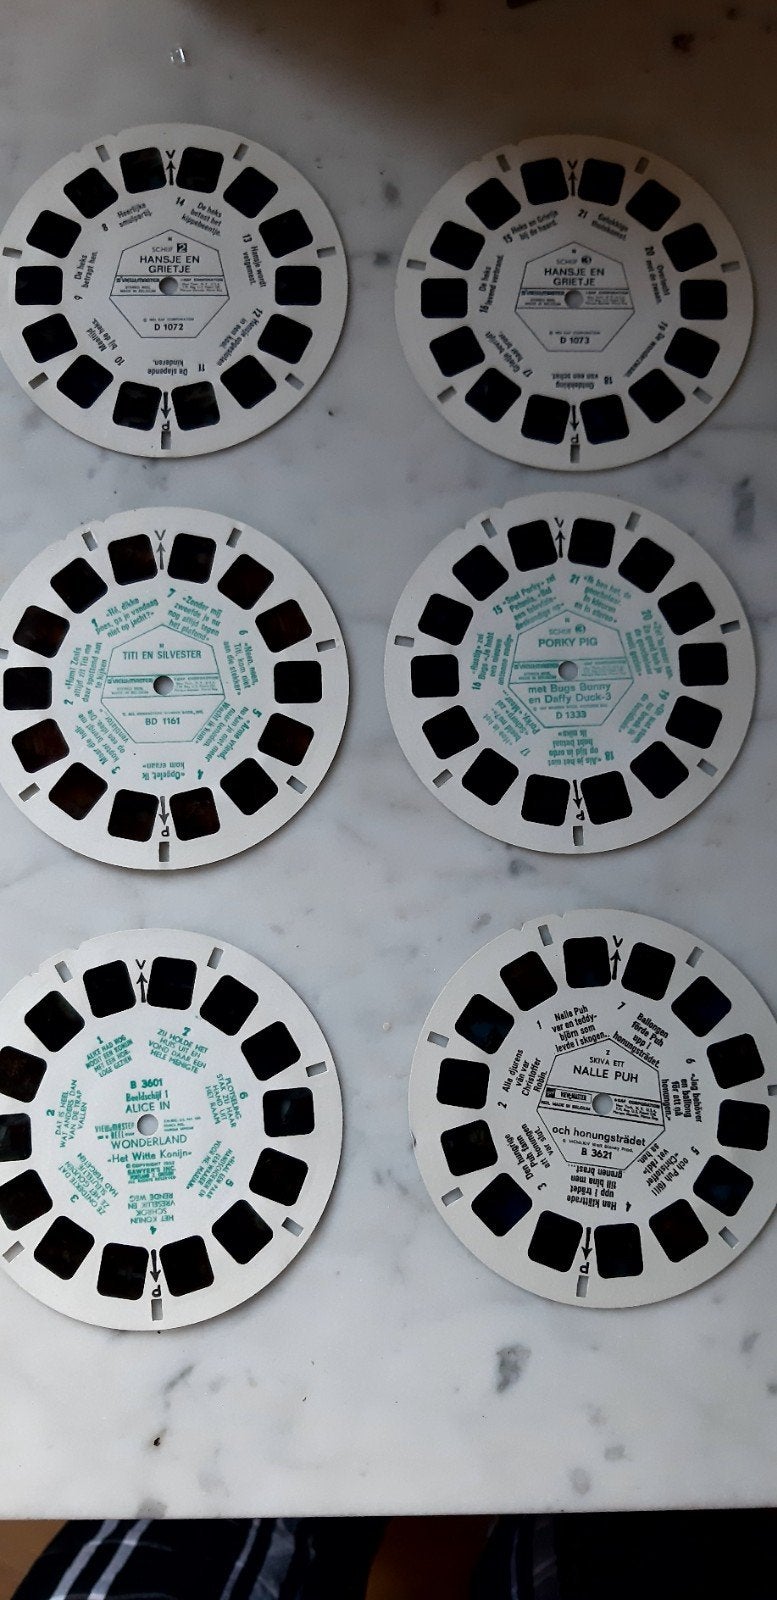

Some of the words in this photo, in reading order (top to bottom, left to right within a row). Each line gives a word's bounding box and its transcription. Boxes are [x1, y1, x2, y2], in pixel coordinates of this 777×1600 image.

[166, 150, 175, 159] V
[177, 243, 187, 253] 2
[148, 265, 190, 273] GRIETJE
[544, 268, 585, 276] HANSJE
[553, 278, 595, 286] GRIETJE
[148, 366, 177, 376] slapende
[556, 380, 594, 389] Ontdekking
[604, 376, 612, 384] 18
[554, 518, 564, 528] V
[155, 530, 166, 540] V
[168, 610, 180, 620] nog
[182, 617, 199, 627] altijd
[201, 624, 219, 636] tegen
[538, 638, 576, 647] PORKY
[579, 637, 598, 646] PIG
[123, 651, 138, 660] TITI
[158, 650, 201, 659] SILVESTER
[550, 684, 575, 693] Bugs
[579, 683, 611, 691] Bunny
[545, 694, 571, 703] Daffy
[576, 692, 611, 701] Duck-3
[78, 714, 87, 723] me
[556, 711, 562, 719] D
[86, 724, 103, 743] brengt
[102, 744, 119, 762] kopter
[198, 769, 203, 780] 4
[613, 935, 623, 948] V
[136, 959, 146, 970] V
[554, 1010, 573, 1021] Nalle
[574, 1005, 588, 1015] Puh
[552, 1024, 563, 1032] var
[574, 1014, 597, 1026] teddy-
[637, 1013, 668, 1038] Ballongen
[559, 1030, 578, 1041] björn
[580, 1025, 596, 1034] som
[632, 1021, 649, 1036] förde
[649, 1033, 663, 1047] Puh
[633, 1035, 646, 1046] upp
[149, 1040, 169, 1053] VOND
[172, 1050, 191, 1062] DAAR
[193, 1059, 206, 1068] EEN
[613, 1031, 660, 1068] honungsträdet.
[150, 1048, 167, 1060] HELE
[169, 1057, 199, 1073] MENIGTE
[590, 1057, 609, 1065] SKIVA
[502, 1078, 513, 1092] Alla
[509, 1050, 523, 1075] djurens
[516, 1072, 525, 1086] vän
[521, 1060, 529, 1071] var
[522, 1058, 541, 1096] Christoffer
[574, 1065, 609, 1078] NALLE
[615, 1071, 638, 1083] PUH
[130, 1080, 137, 1089] B
[142, 1078, 162, 1088] 3601
[533, 1071, 547, 1092] Robin.
[672, 1081, 680, 1092] för
[681, 1079, 688, 1088] en
[126, 1090, 161, 1102] Beeldschijf
[165, 1090, 168, 1098] 1
[225, 1078, 241, 1119] PLOTSELING
[126, 1102, 154, 1113] ALICE
[160, 1101, 170, 1110] IN
[205, 1086, 214, 1098] HET
[210, 1102, 221, 1124] RAAM
[682, 1090, 692, 1117] ballong
[78, 1102, 87, 1129] VALLEN
[673, 1107, 683, 1116] nå
[532, 1126, 546, 1142] slut.
[552, 1127, 570, 1135] och
[574, 1128, 645, 1146] honungsträdet
[111, 1134, 187, 1149] WONDERLAND
[513, 1135, 529, 1152] fann
[522, 1124, 543, 1157] honungen
[505, 1134, 527, 1165] hungrige
[544, 1144, 553, 1156] var
[650, 1143, 659, 1152] sa
[691, 1146, 700, 1155] 5
[108, 1154, 128, 1162] «Het
[132, 1152, 156, 1160] Witte
[160, 1149, 192, 1158] Konijn»
[526, 1152, 538, 1168] Puh
[591, 1149, 612, 1159] 3621
[638, 1151, 653, 1163] han.
[77, 1153, 104, 1182] VERGETEN
[540, 1158, 550, 1168] att
[522, 1164, 534, 1180] Den
[646, 1153, 678, 1186] «Christoffer
[78, 1164, 107, 1196] SLEUTELTJE
[589, 1177, 604, 1187] bina
[607, 1180, 616, 1189] till
[105, 1183, 118, 1197] HAD
[570, 1185, 592, 1195] trädet
[595, 1189, 597, 1197] i
[601, 1188, 614, 1197] upp
[70, 1194, 79, 1203] 3
[129, 1194, 146, 1202] WEG
[567, 1195, 599, 1208] klättrade
[602, 1200, 616, 1210] Han
[626, 1202, 631, 1212] 4
[150, 1226, 156, 1234] 4
